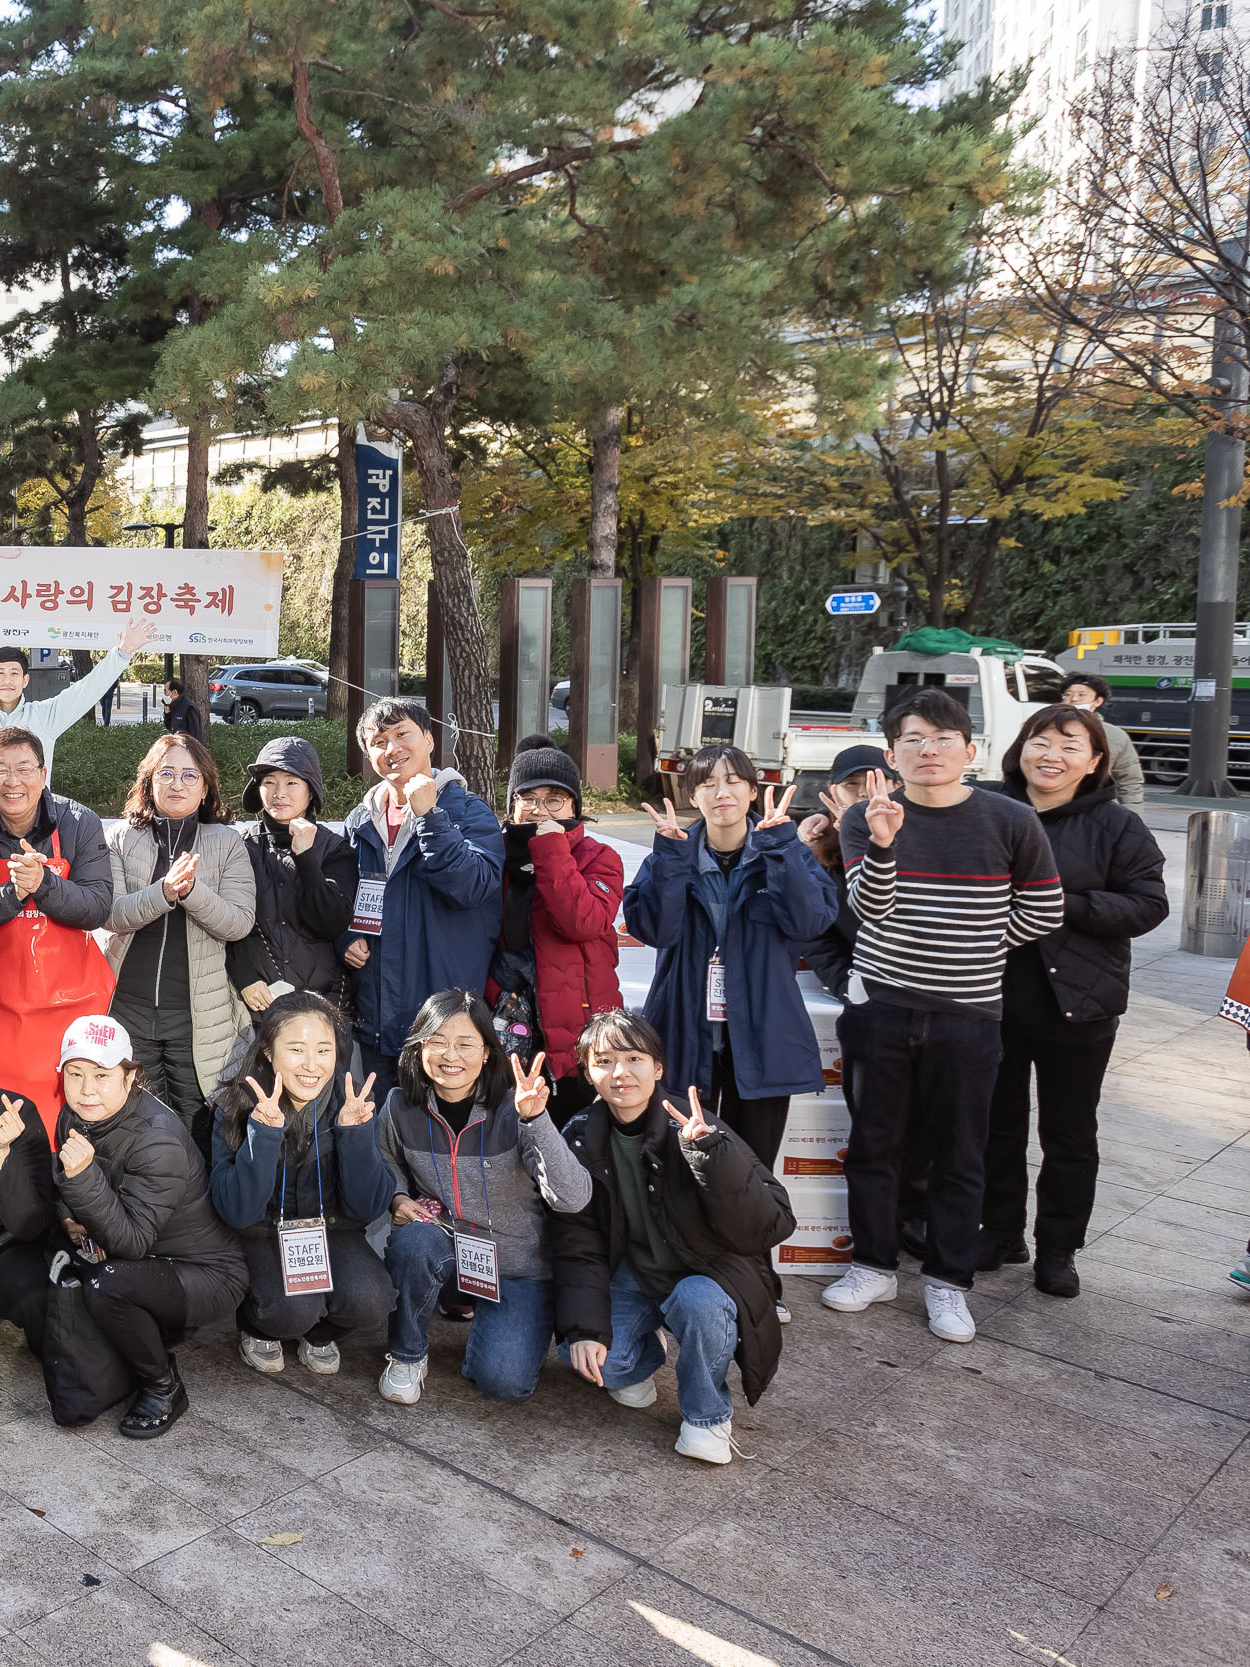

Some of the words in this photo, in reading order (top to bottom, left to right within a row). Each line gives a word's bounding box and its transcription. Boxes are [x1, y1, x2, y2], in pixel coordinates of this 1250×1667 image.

[366, 469, 393, 574] 광진구의
[1, 579, 94, 612] 사랑의
[108, 581, 235, 616] 김장축제
[2, 628, 29, 637] 광진구
[62, 630, 99, 639] 광진복지재단
[40, 648, 52, 662] P
[288, 1243, 320, 1256] STAFF
[461, 1249, 491, 1264] STAFF
[288, 1255, 323, 1267] 진행요원
[461, 1259, 493, 1276] 진행요원
